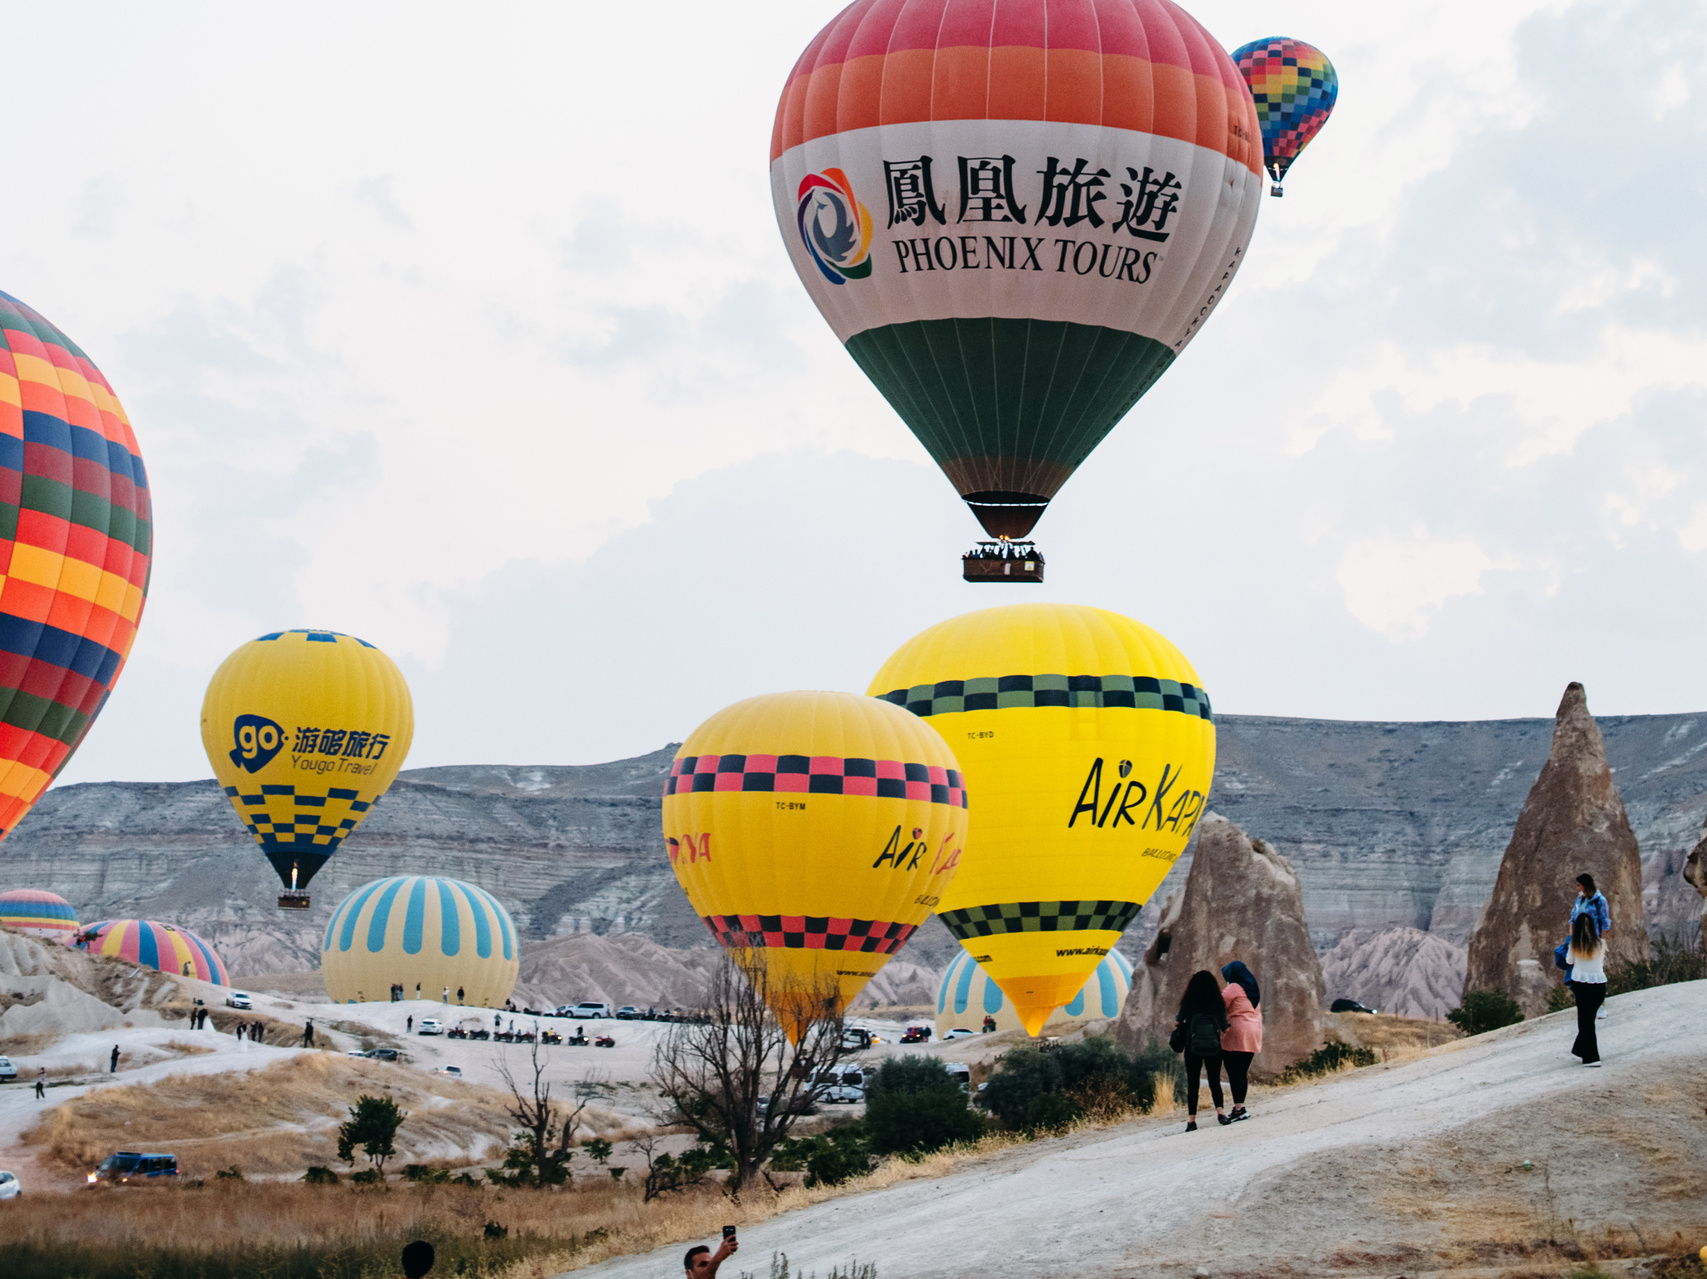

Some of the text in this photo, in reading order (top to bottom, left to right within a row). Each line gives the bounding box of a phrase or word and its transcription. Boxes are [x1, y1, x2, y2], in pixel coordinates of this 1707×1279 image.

[883, 154, 1182, 243] 鳳凰旅遊
[892, 236, 1158, 284] PHOENIX TOURS
[239, 725, 279, 759] go
[291, 755, 378, 776] Yougo Travel
[776, 802, 806, 810] TC-BYM
